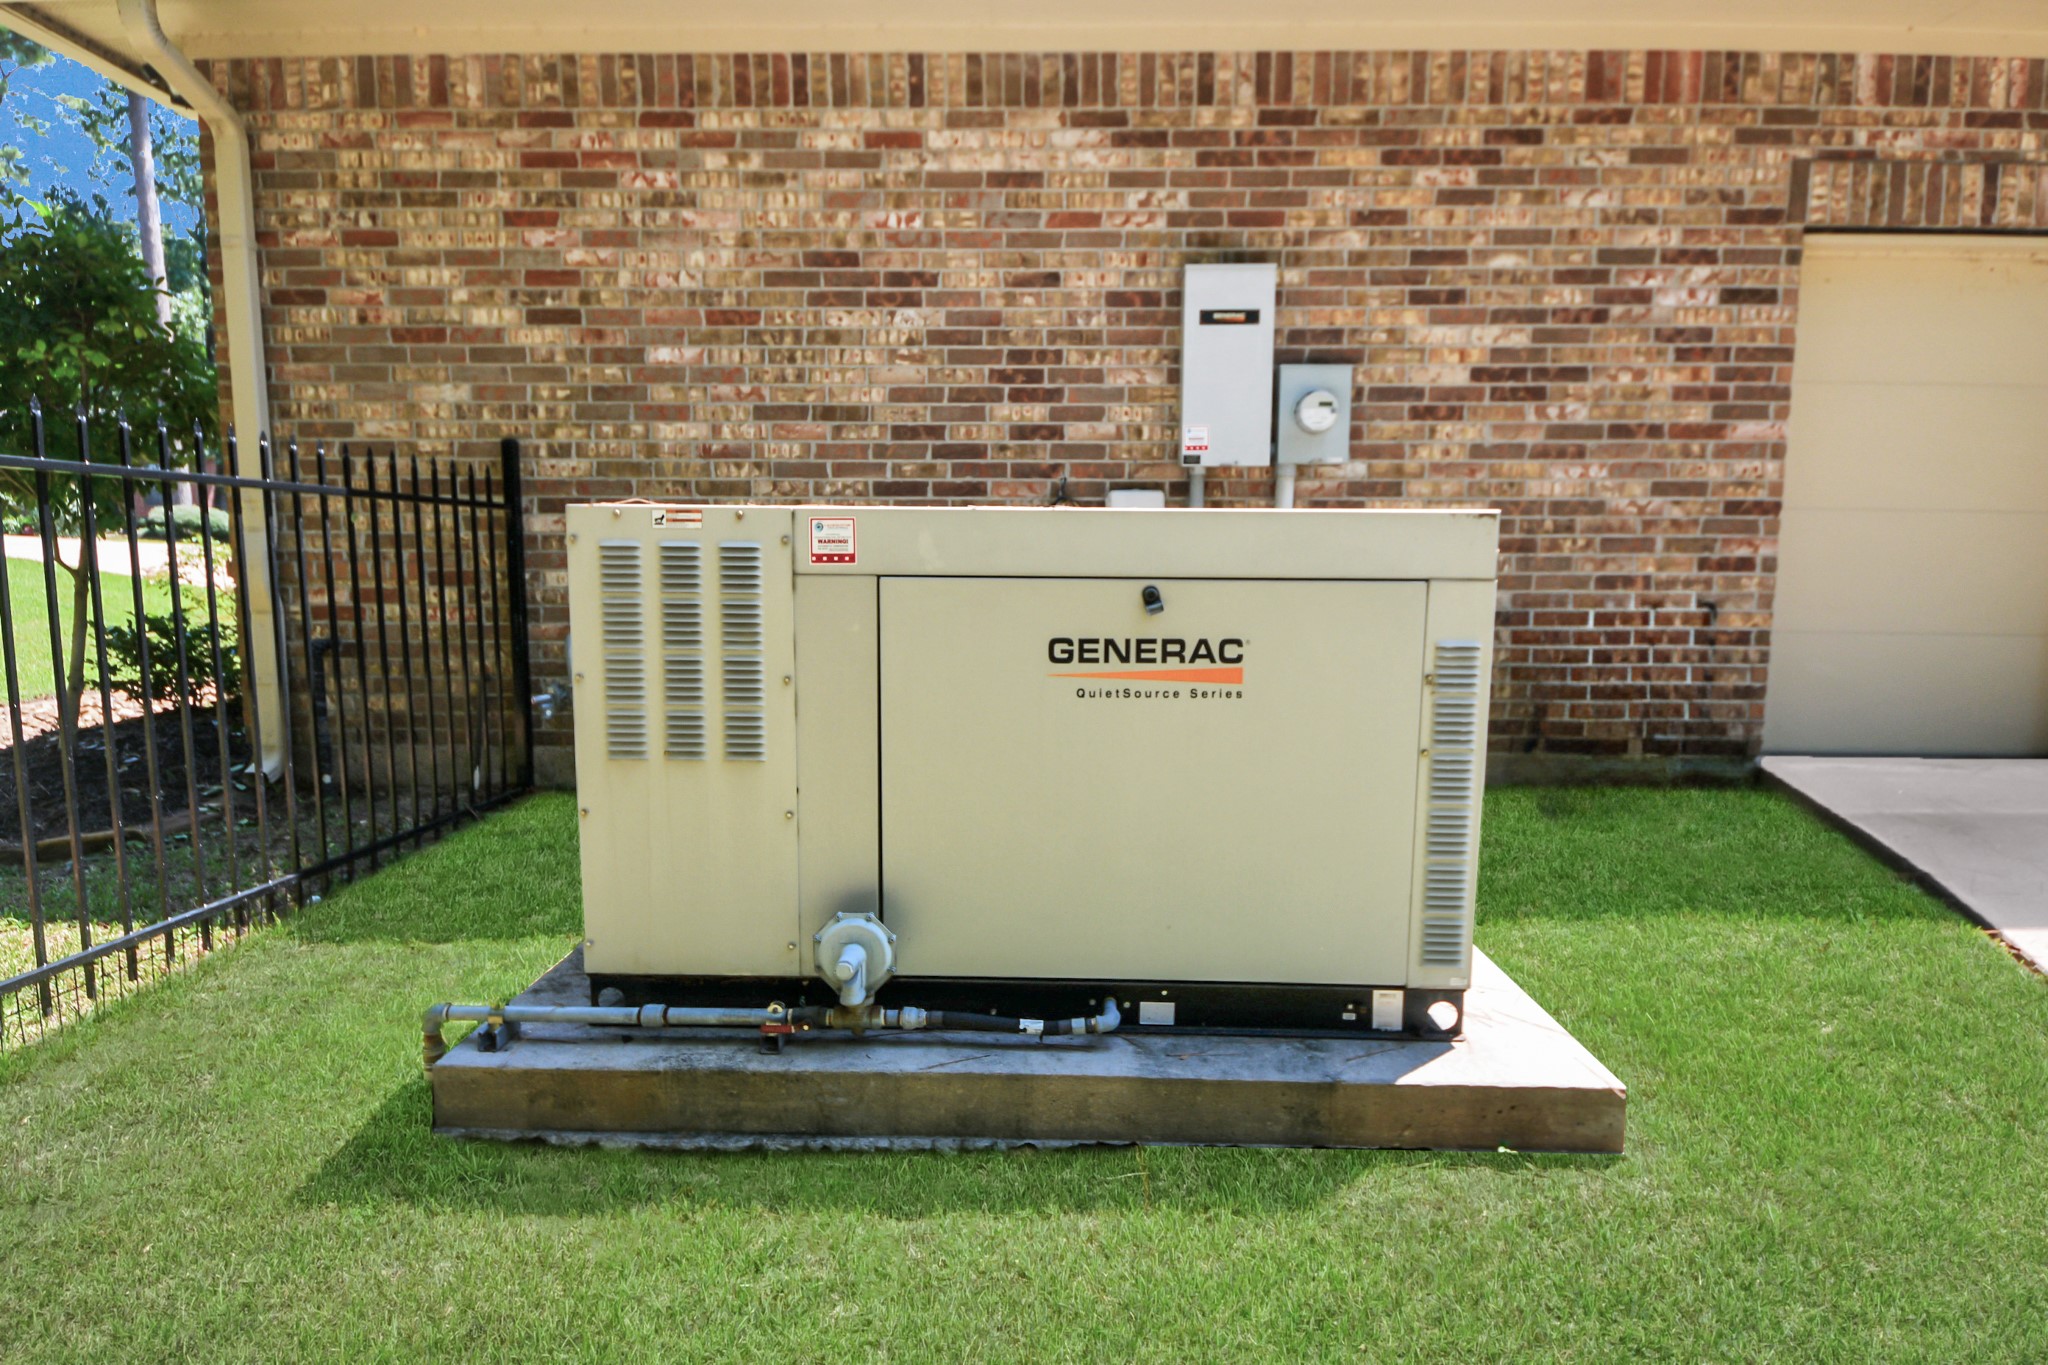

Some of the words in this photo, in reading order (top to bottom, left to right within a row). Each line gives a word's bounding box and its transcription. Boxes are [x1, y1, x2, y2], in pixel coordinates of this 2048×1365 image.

[1048, 638, 1244, 664] GENERAC
[1076, 688, 1180, 699] QuietSource
[1190, 688, 1243, 699] Series
